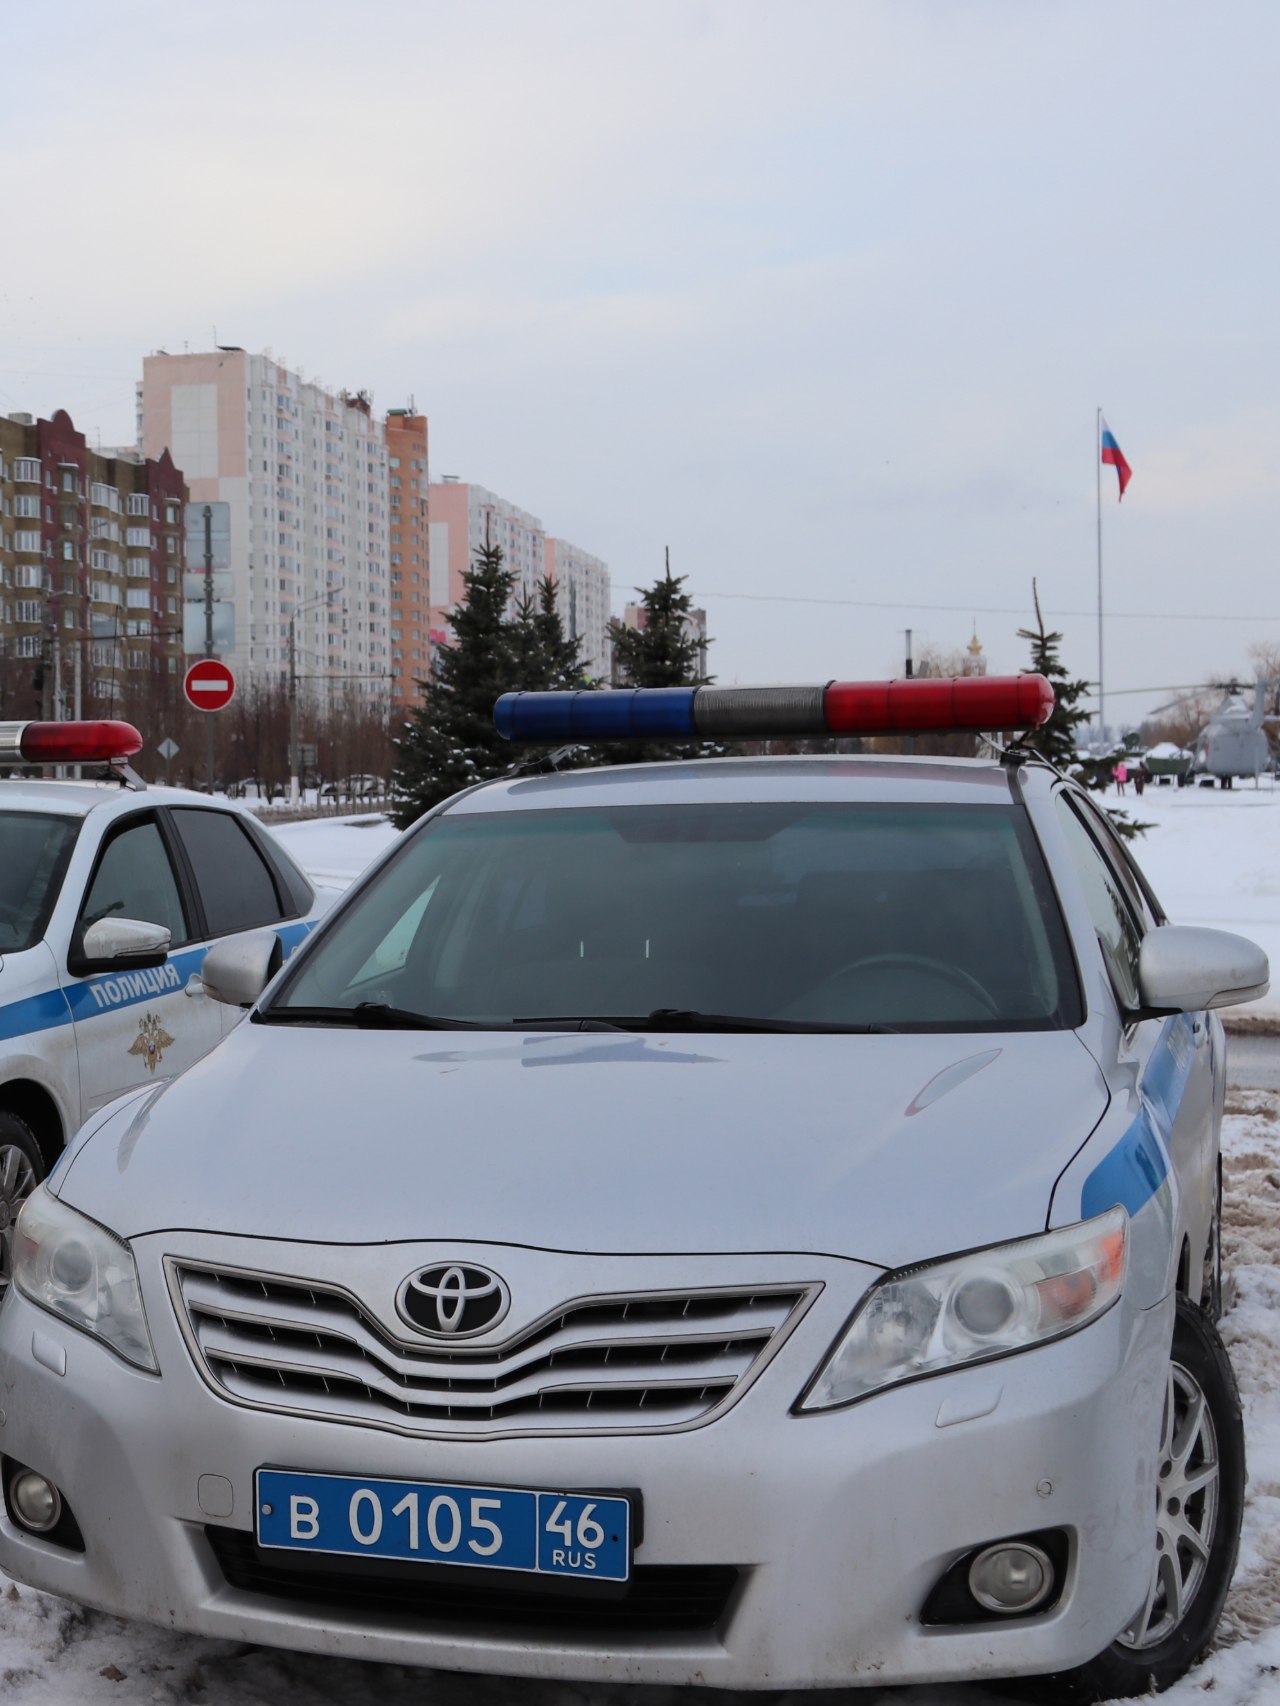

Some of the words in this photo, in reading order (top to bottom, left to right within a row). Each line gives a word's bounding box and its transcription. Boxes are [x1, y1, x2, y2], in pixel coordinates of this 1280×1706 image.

[89, 963, 182, 1008] ПОЛИЦИЯ
[348, 1488, 504, 1556] 0105
[545, 1500, 605, 1549] 46
[552, 1549, 596, 1570] RUS
